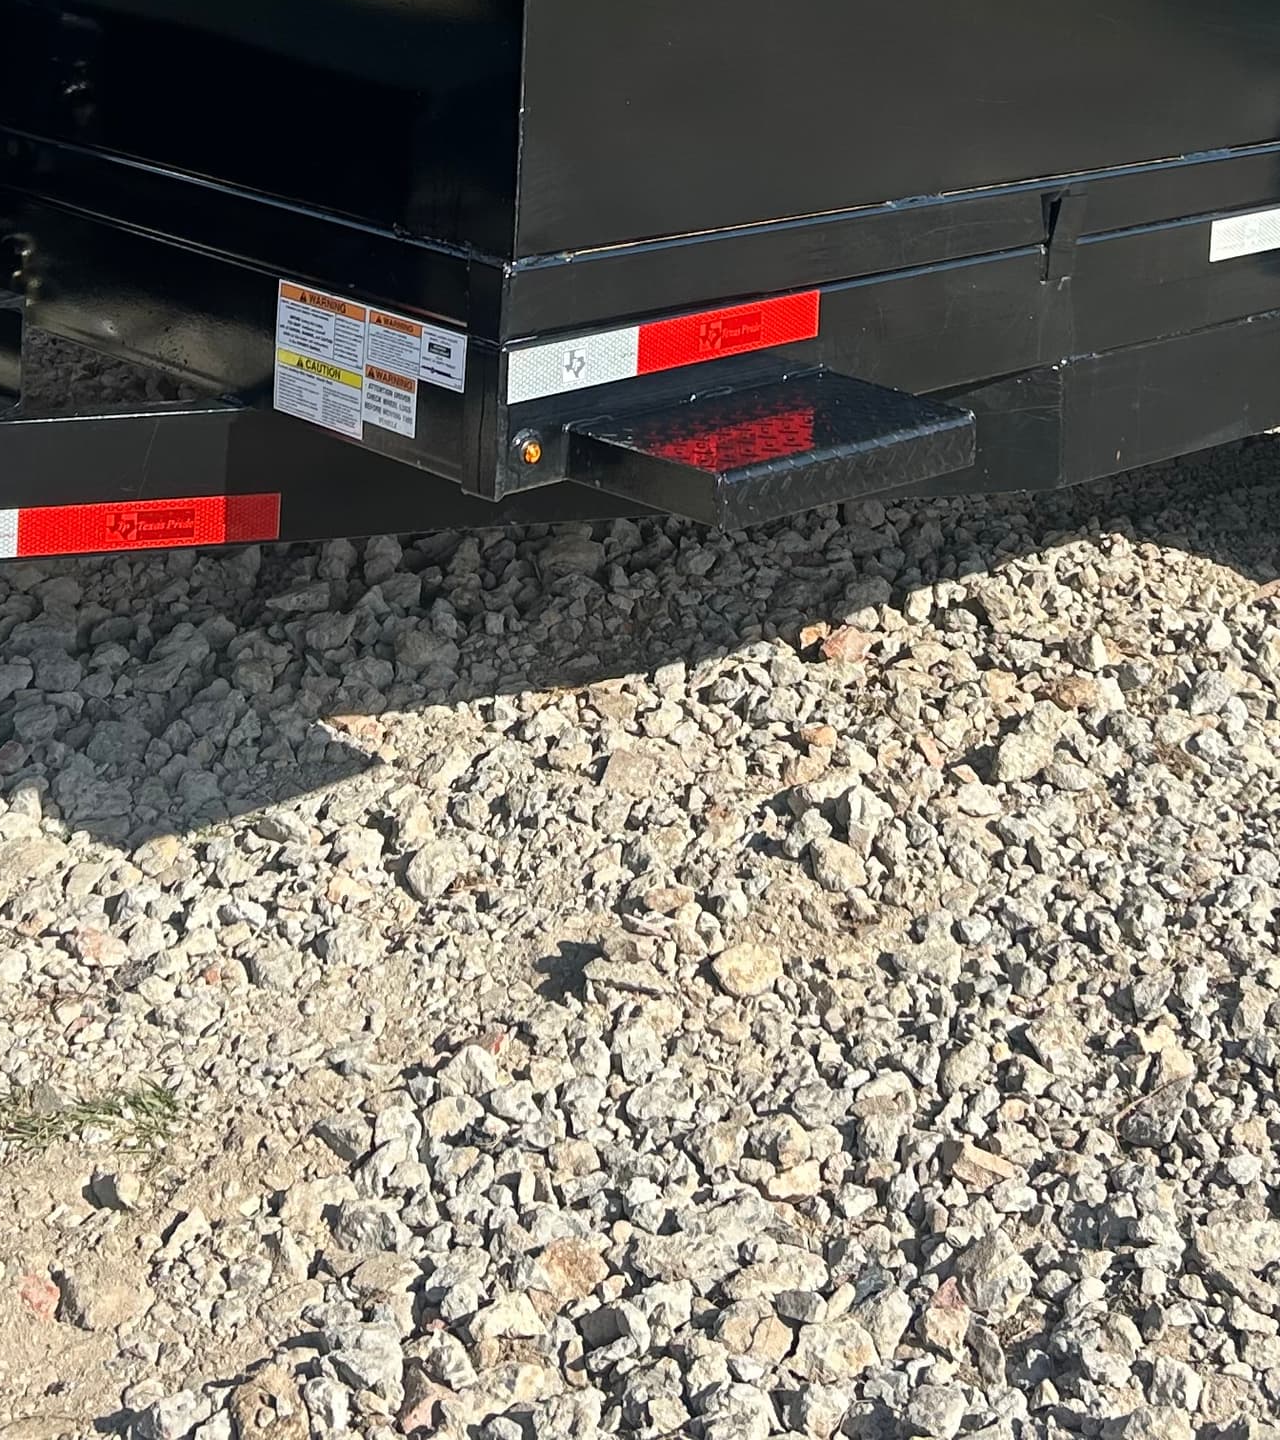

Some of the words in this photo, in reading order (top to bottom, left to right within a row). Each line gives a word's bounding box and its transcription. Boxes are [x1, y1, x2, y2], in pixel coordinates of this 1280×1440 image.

[308, 294, 347, 314] WARNING
[383, 318, 414, 333] WARNING
[305, 359, 341, 380] CAUTION
[375, 369, 413, 391] WARNING
